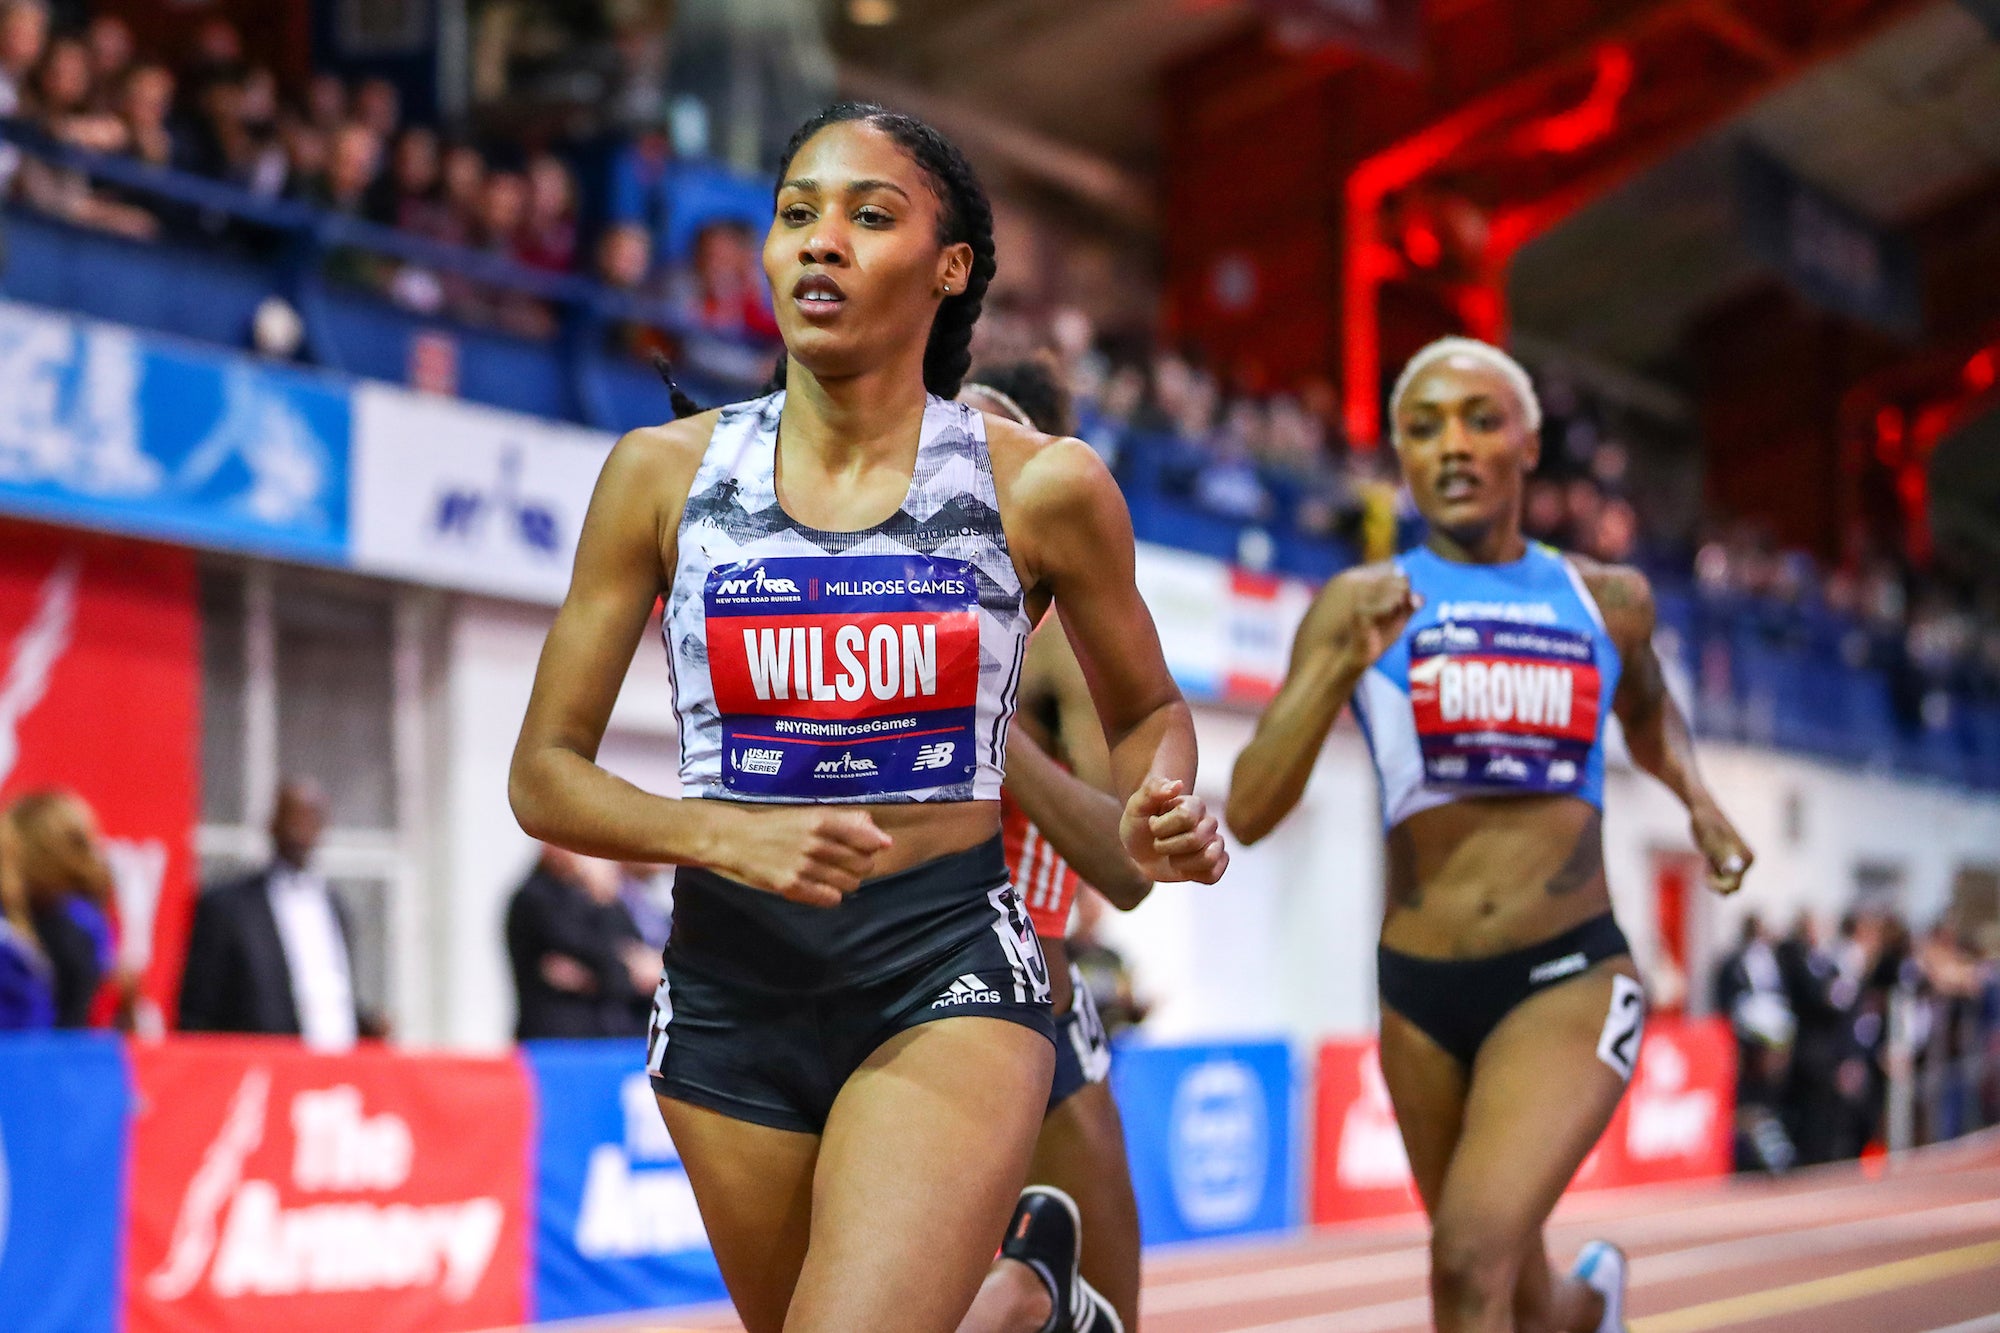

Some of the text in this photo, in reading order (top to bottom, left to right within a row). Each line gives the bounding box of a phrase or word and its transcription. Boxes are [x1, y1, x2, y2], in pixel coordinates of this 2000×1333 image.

[825, 580, 965, 596] MILLROSE GAMES
[770, 595, 802, 603] RUNNERS
[742, 624, 937, 703] WILSON
[1439, 661, 1574, 728] BROWN
[775, 717, 918, 737] #NYRRMillroseGames
[748, 748, 784, 761] USATF
[748, 763, 777, 773] SERIES
[931, 988, 1002, 1010] adidas
